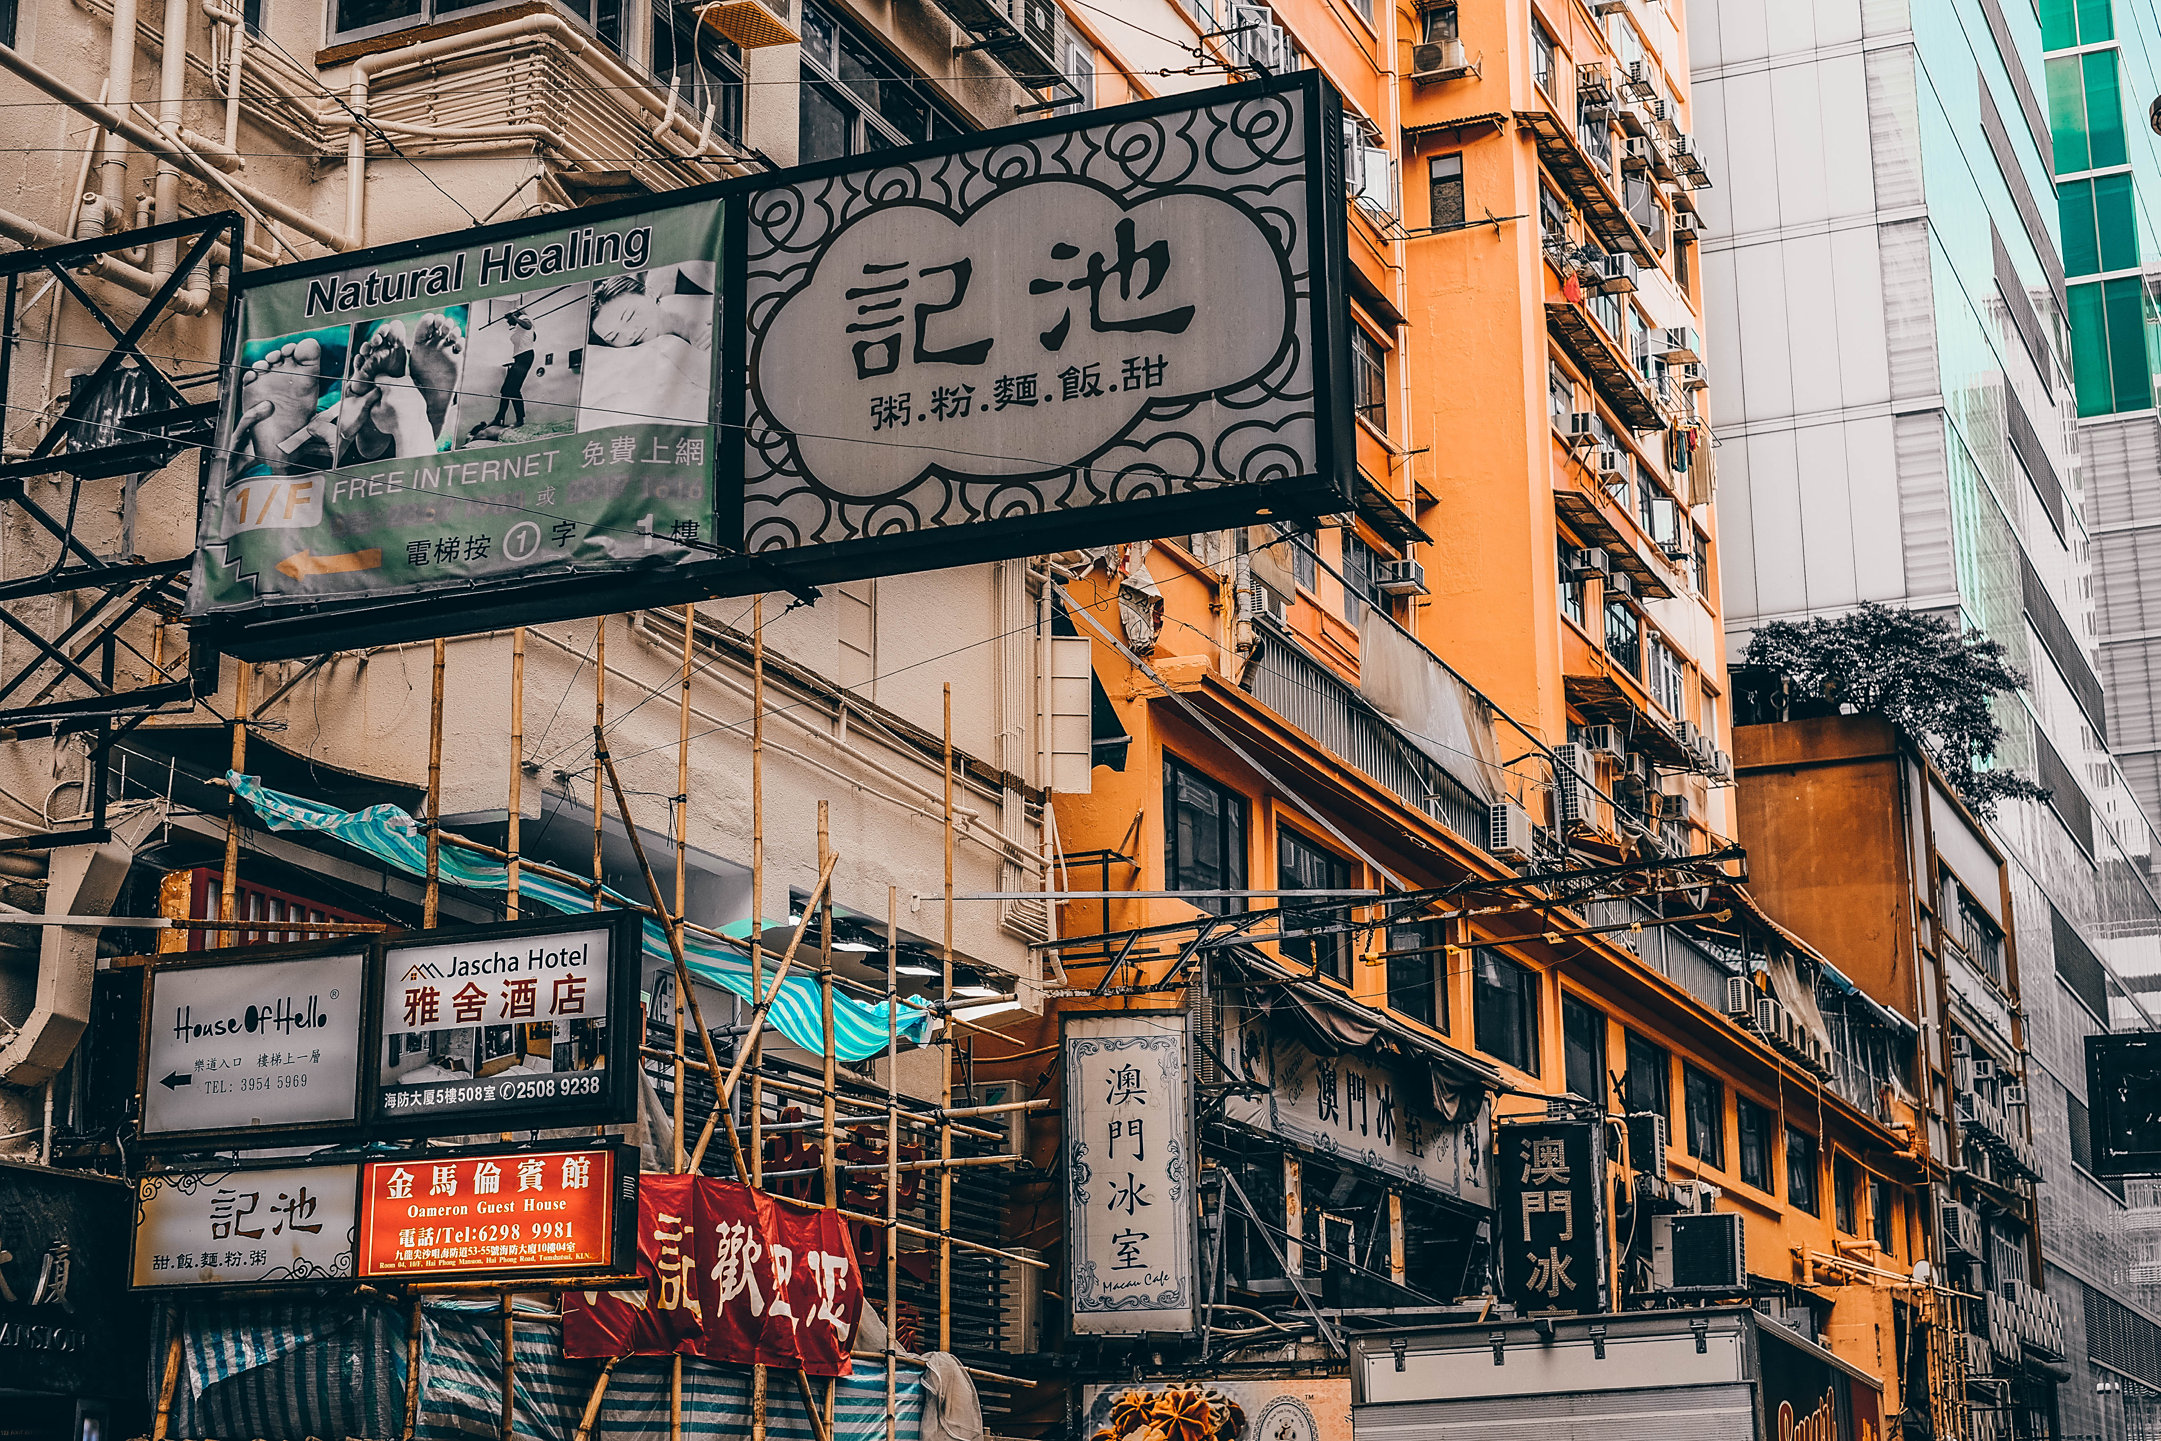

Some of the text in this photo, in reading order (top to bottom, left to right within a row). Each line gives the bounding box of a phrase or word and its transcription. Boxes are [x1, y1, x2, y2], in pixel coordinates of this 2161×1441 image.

[304, 225, 653, 318] Natural Healing
[581, 436, 705, 468] 免費上網
[332, 471, 404, 503] FREE
[412, 450, 560, 488] INTERNET
[235, 481, 313, 525] 1/F
[536, 486, 556, 506] 或
[406, 534, 491, 567] 電梯按
[552, 521, 576, 548] 字
[447, 944, 588, 978] Jascha Hotel
[404, 972, 587, 1027] 雅舍酒店
[257, 1049, 321, 1067] 樓梯上一層
[205, 1073, 308, 1094] TEL: 3954 5969
[560, 1076, 600, 1096] 9238
[386, 1156, 591, 1200] 金馬倫賓館
[1105, 1063, 1152, 1270] 澳門冰室
[476, 1201, 515, 1214] Guest
[524, 1198, 567, 1212] House
[531, 1221, 573, 1240] 9981
[1520, 1136, 1578, 1318] 澳門冰
[1102, 1270, 1170, 1293] Macau Cafe
